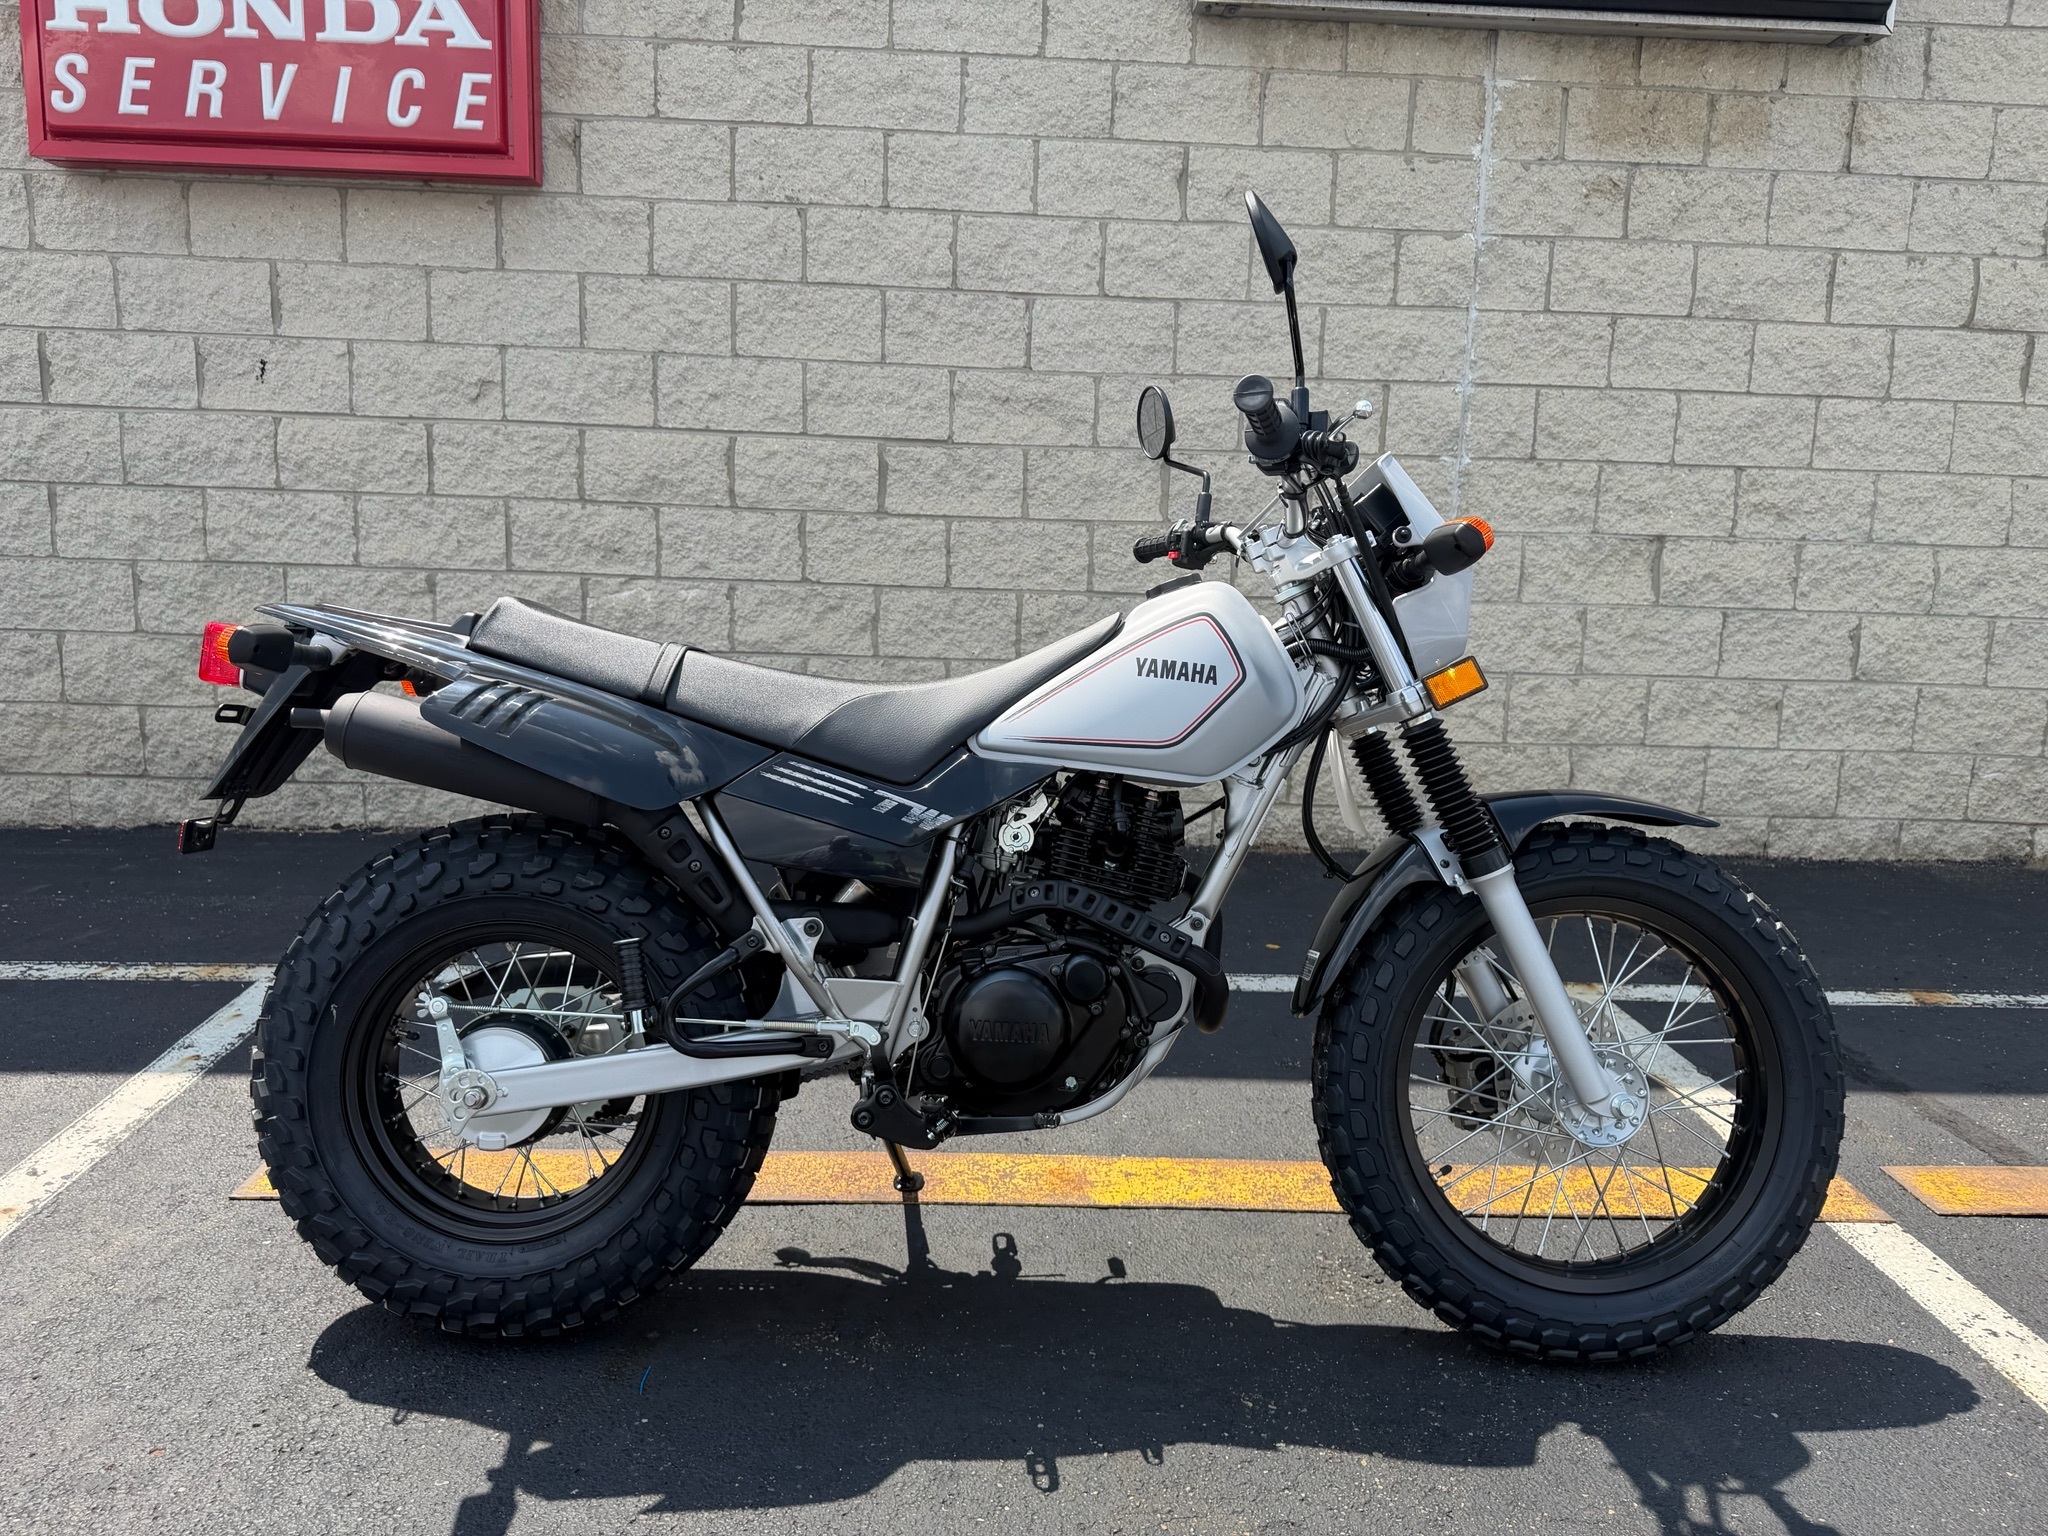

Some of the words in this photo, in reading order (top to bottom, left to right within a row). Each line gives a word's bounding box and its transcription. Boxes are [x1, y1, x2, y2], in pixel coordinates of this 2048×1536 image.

[45, 0, 493, 50] HONDA
[51, 53, 493, 132] SERVICE
[1136, 657, 1218, 686] YAMAHA
[969, 1019, 1050, 1044] YAMAHA
[456, 1247, 508, 1263] TRAIL
